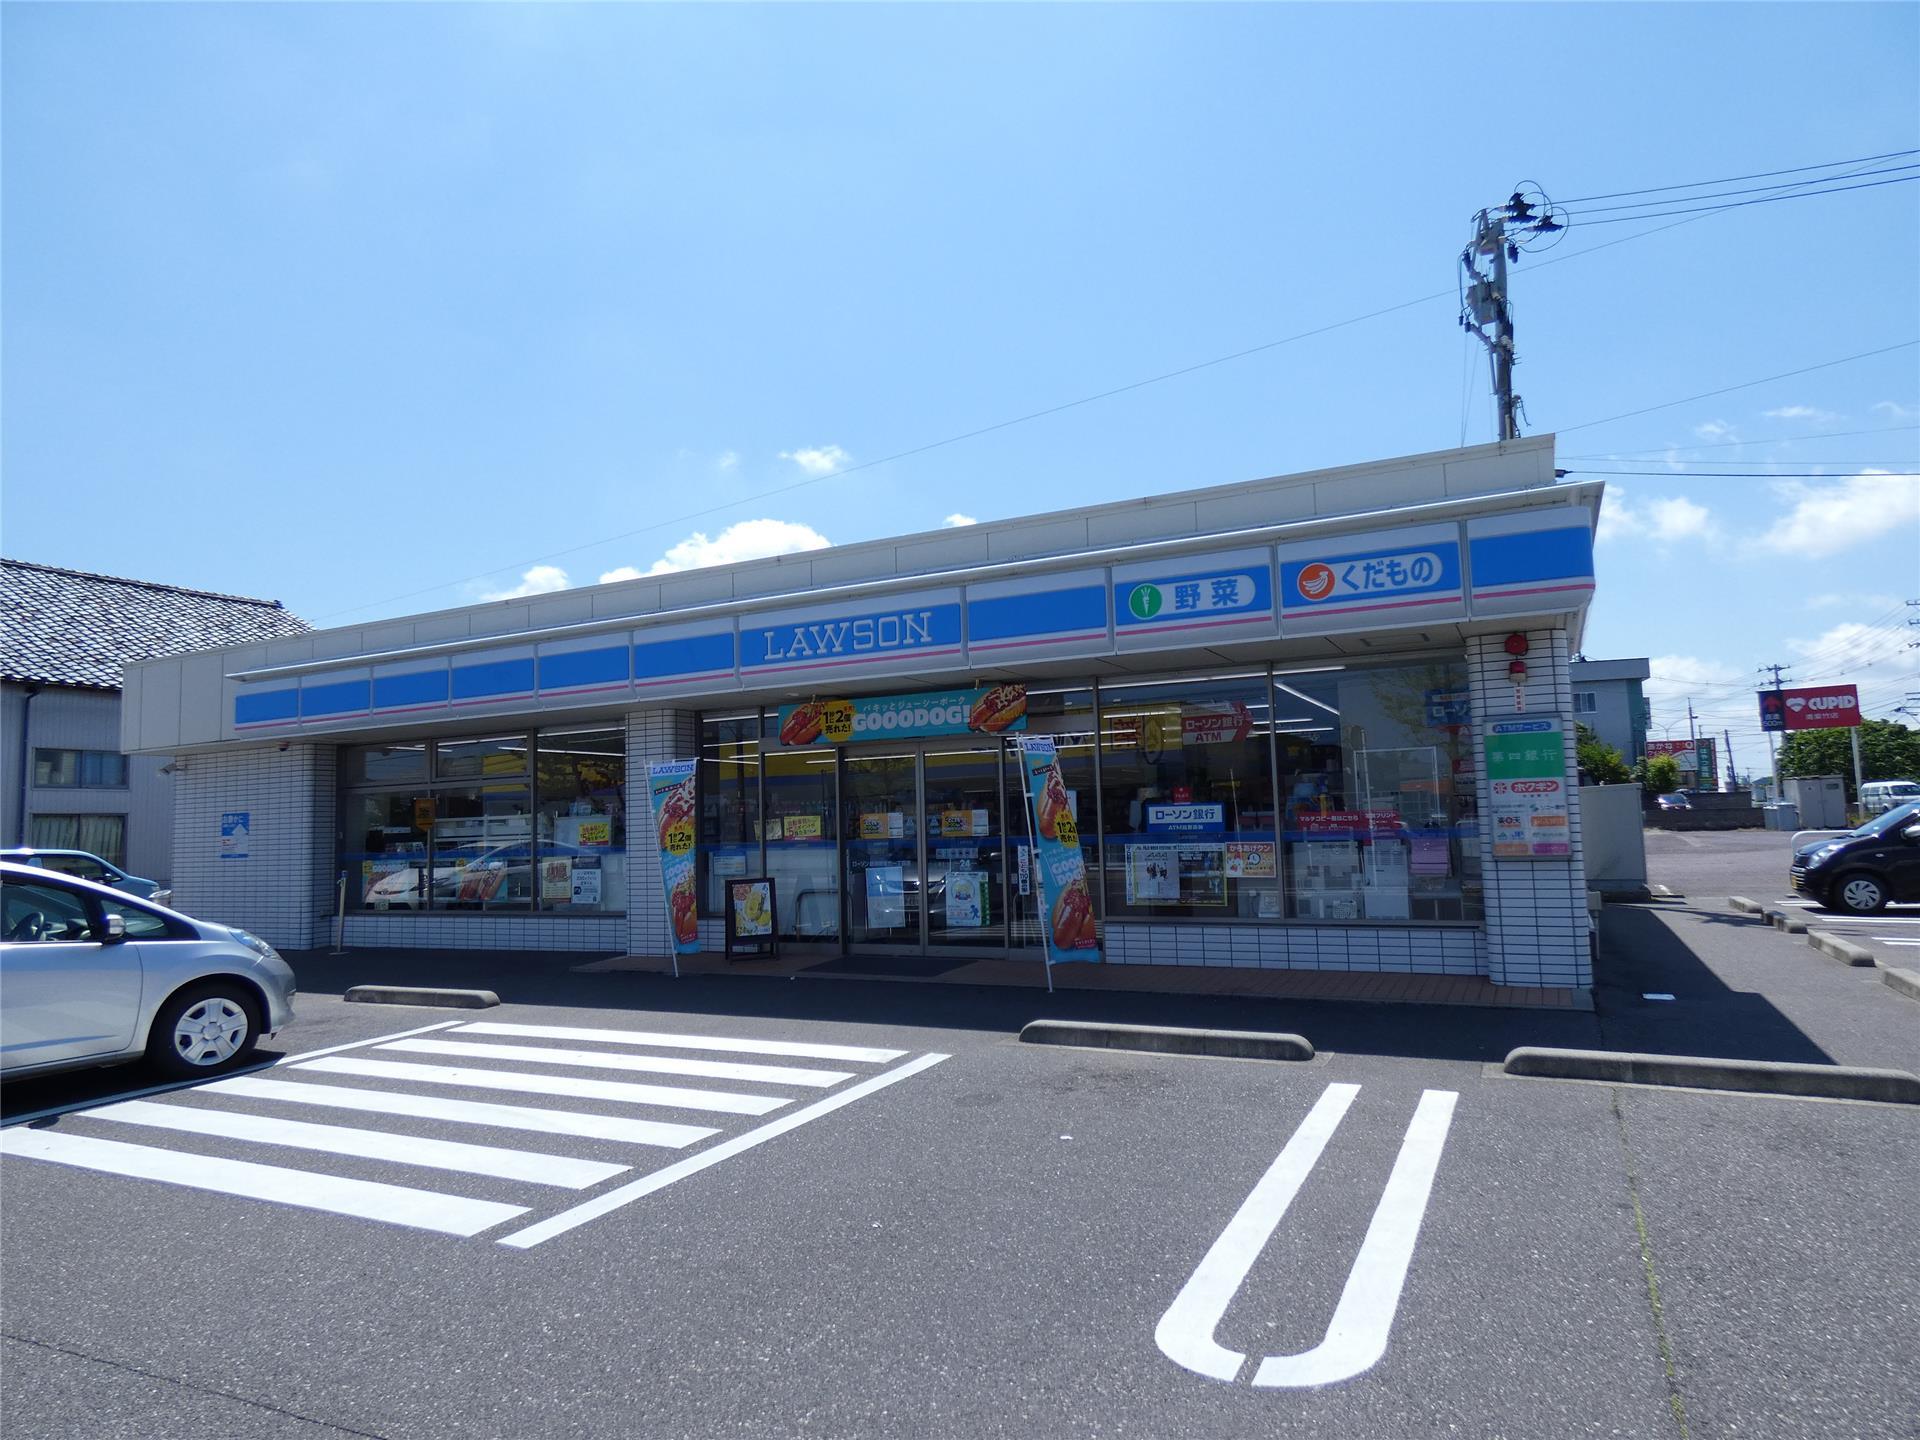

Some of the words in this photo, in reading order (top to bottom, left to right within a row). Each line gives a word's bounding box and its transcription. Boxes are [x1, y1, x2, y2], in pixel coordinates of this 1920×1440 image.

[1341, 556, 1434, 592] くだもの
[1174, 578, 1239, 611] 野菜
[764, 611, 932, 660] LAWSON
[863, 696, 965, 712] パキッとジューシーポーク
[1807, 695, 1856, 711] CUPID
[852, 705, 970, 732] GOOODOG!
[1186, 716, 1243, 730] ローソン銀行
[1195, 732, 1222, 743] ATM
[1024, 742, 1055, 753] LAWSON
[652, 764, 694, 775] LAWSON
[1155, 808, 1216, 820] ローソン銀行
[1229, 842, 1271, 853] からあげクン
